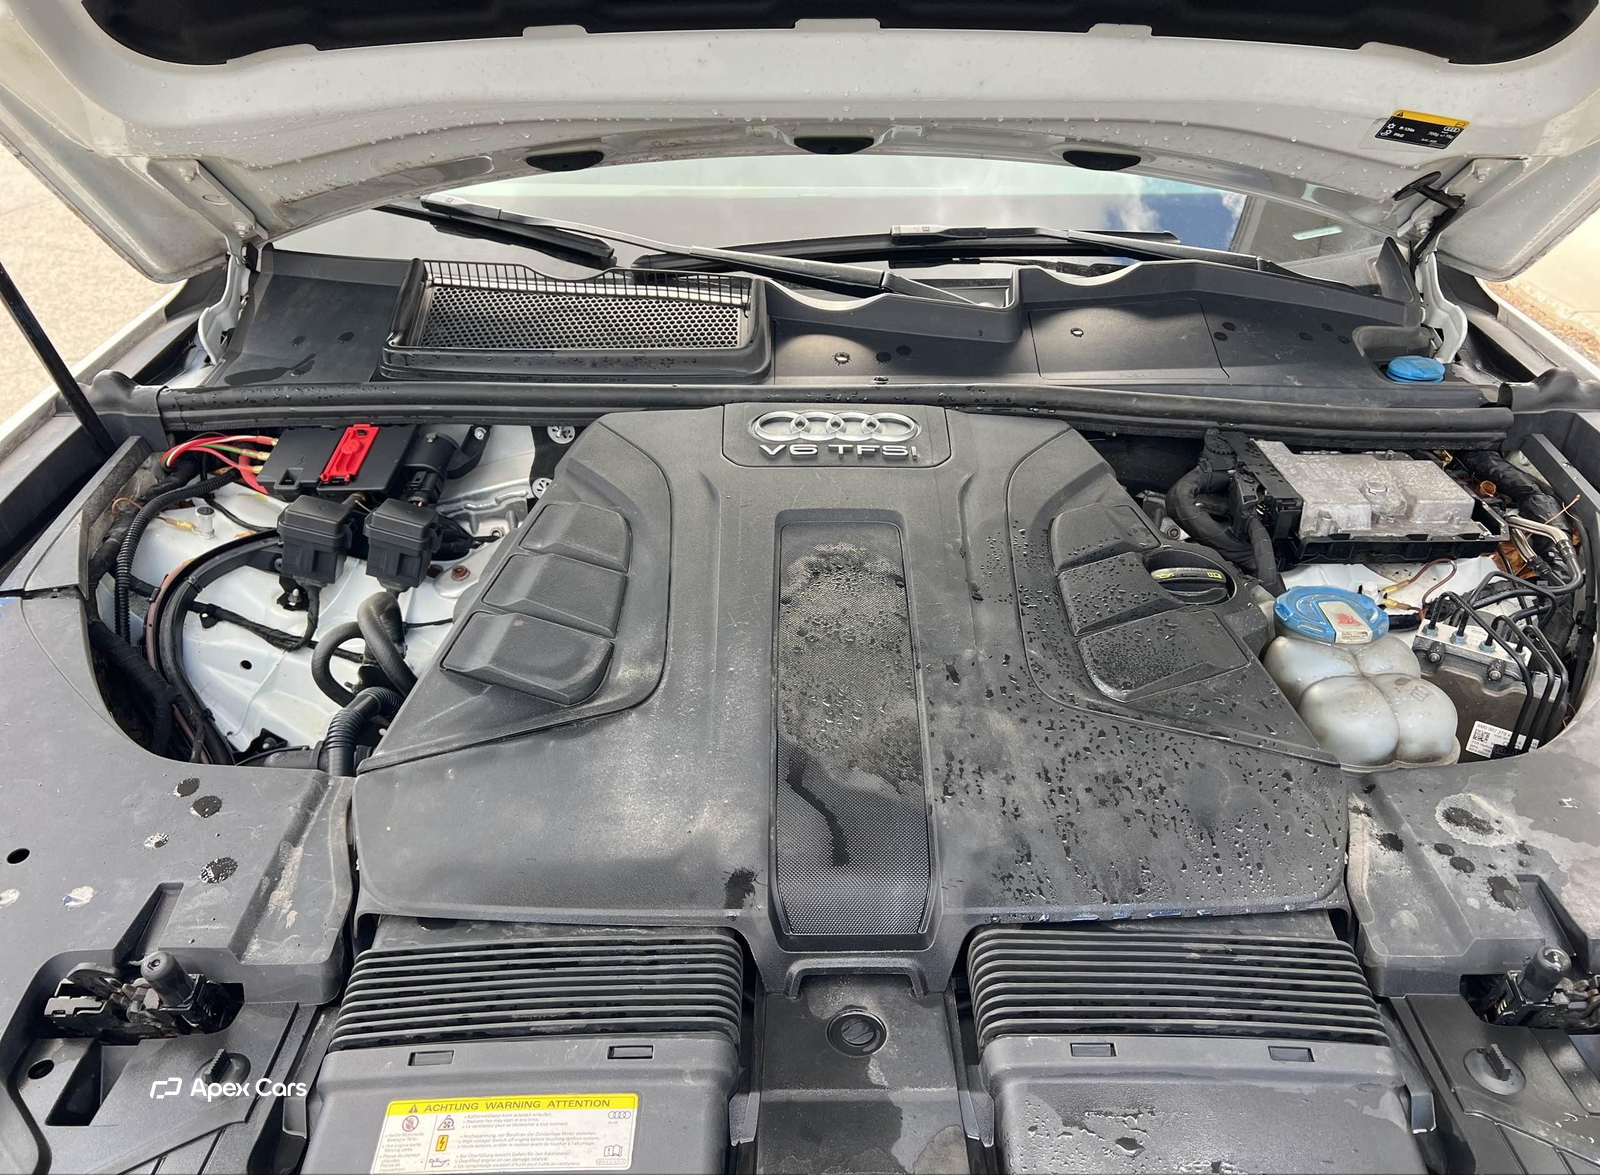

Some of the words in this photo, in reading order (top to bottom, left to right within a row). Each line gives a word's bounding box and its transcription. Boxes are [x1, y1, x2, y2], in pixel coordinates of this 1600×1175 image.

[759, 444, 818, 457] V6
[828, 444, 918, 460] TFSI
[424, 1103, 479, 1113] ACHTUNG
[486, 1100, 541, 1110] WARNING
[547, 1100, 610, 1108] ATTENTION
